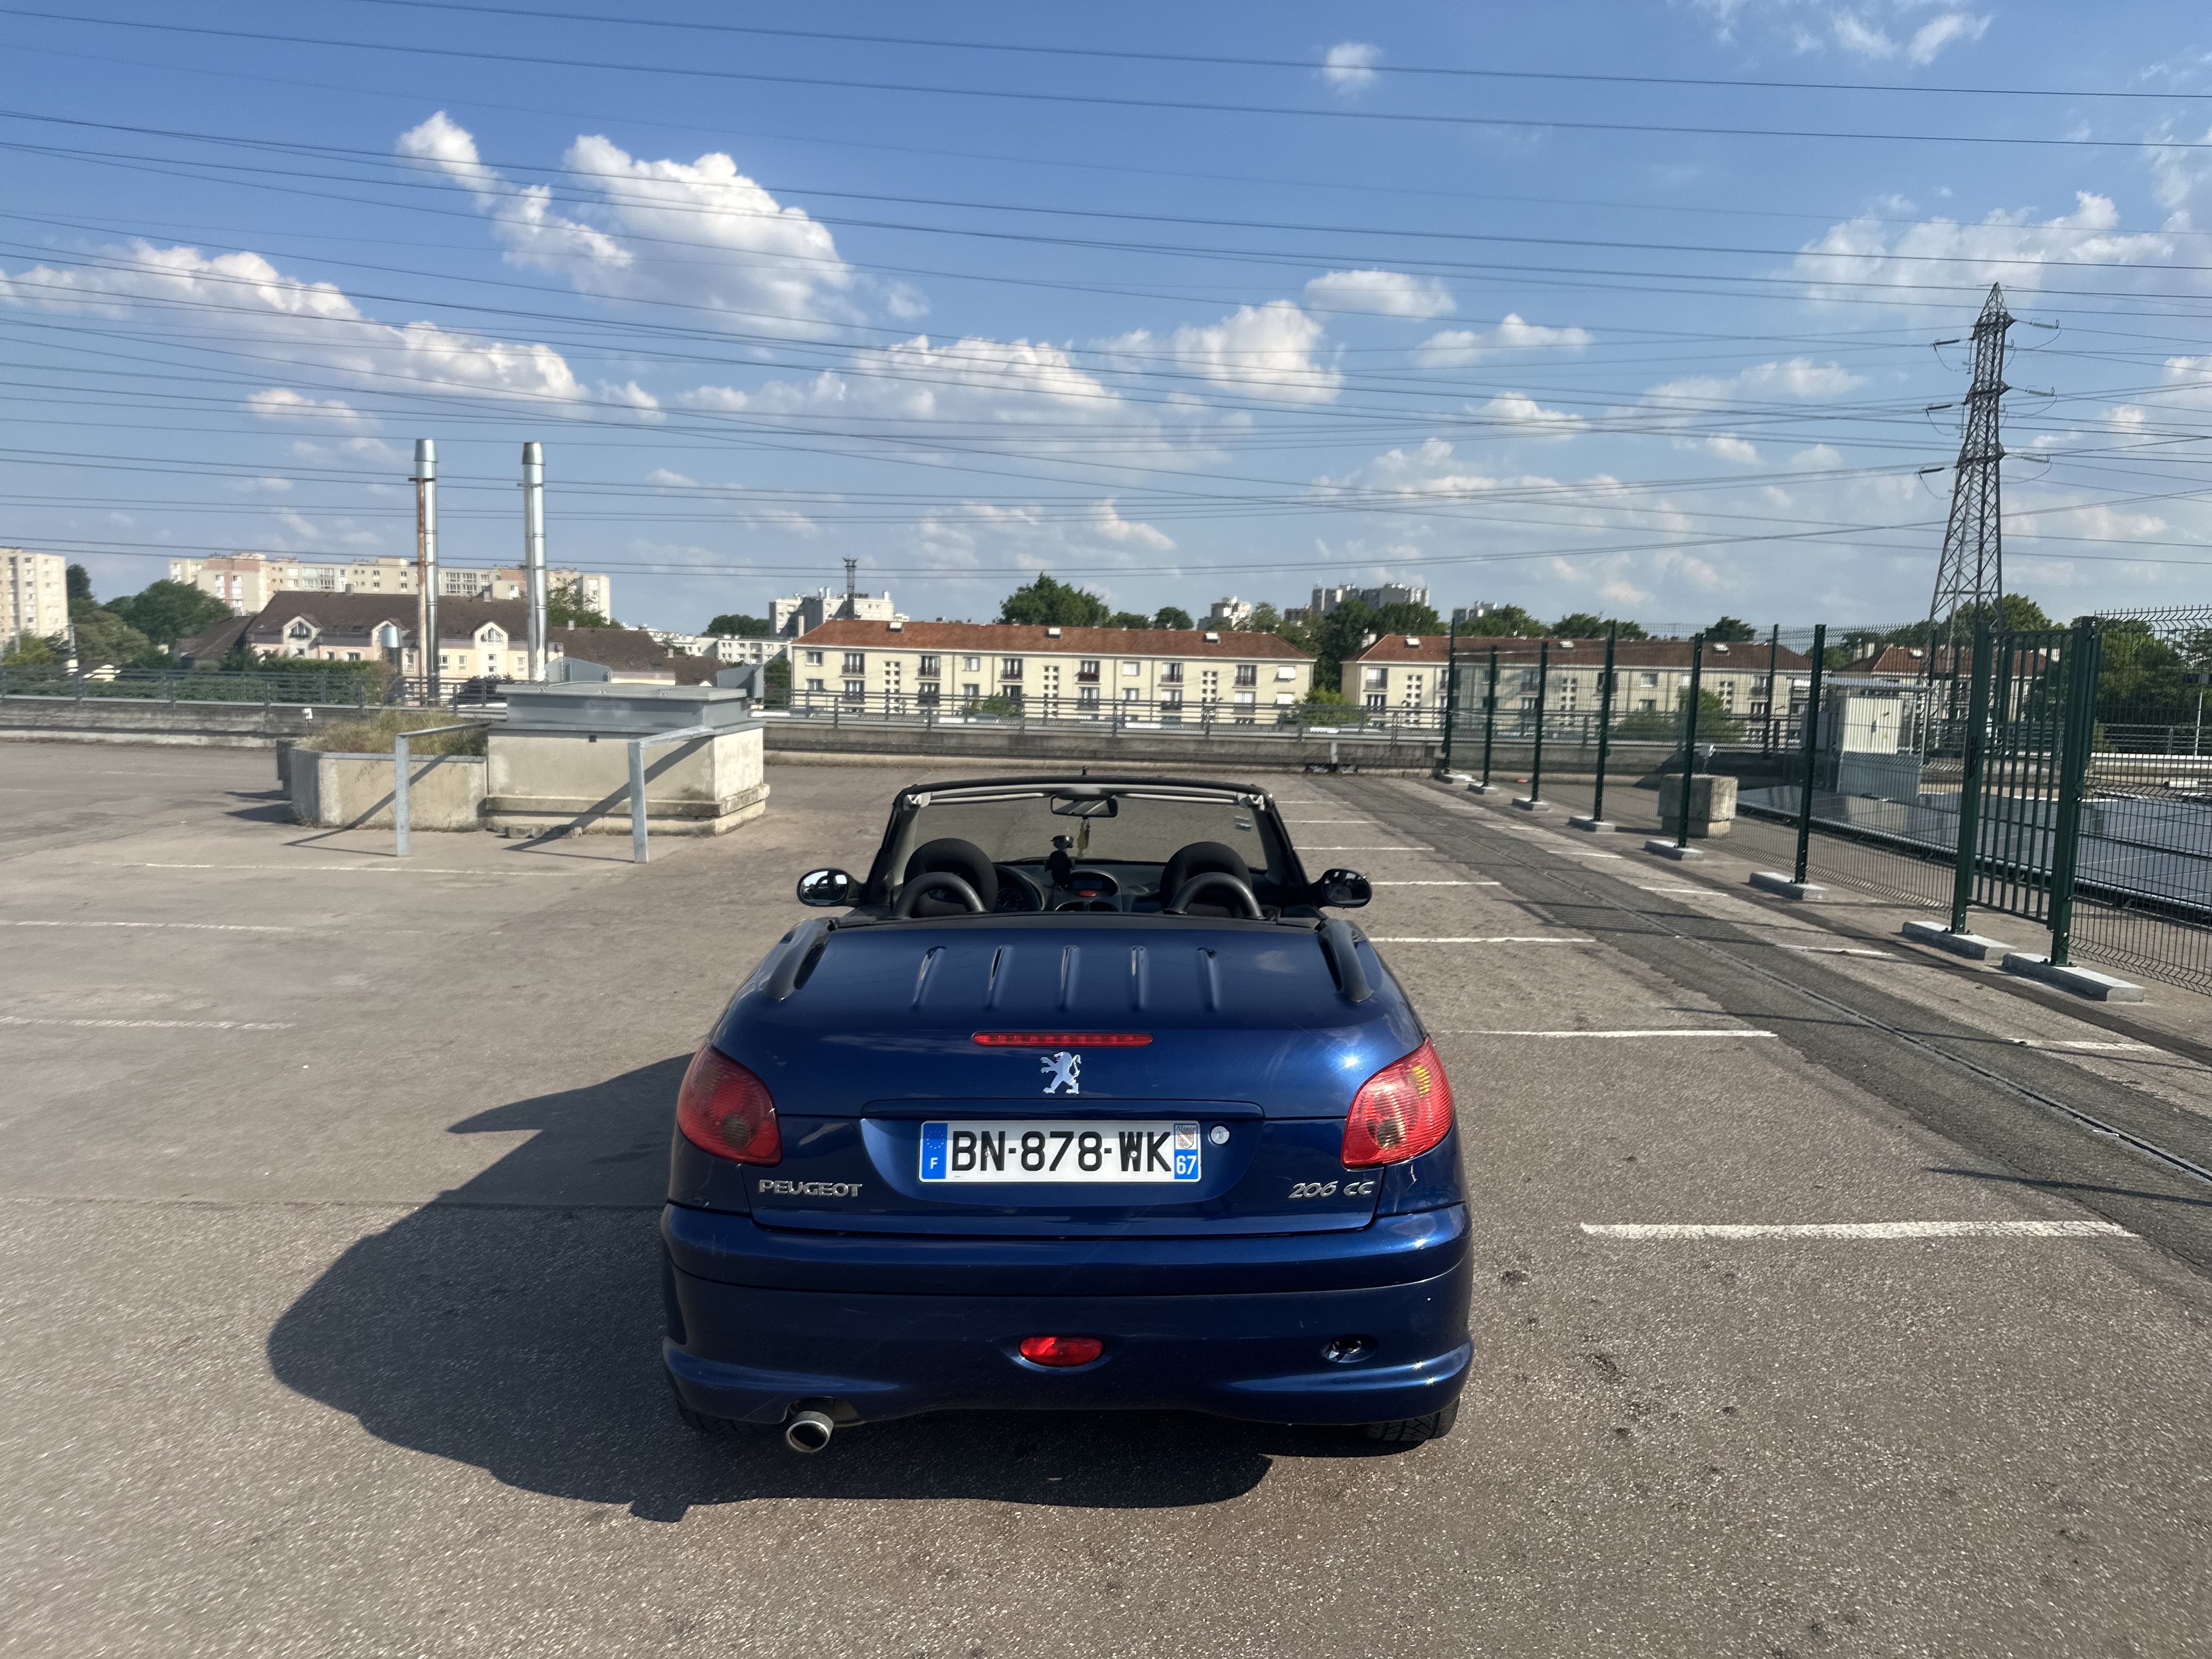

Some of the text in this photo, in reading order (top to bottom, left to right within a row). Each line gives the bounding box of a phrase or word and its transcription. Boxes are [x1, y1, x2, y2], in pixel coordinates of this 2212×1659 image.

[951, 1131, 1172, 1172] BN-878-WK
[930, 1157, 938, 1169] F
[1176, 1155, 1196, 1175] 67
[759, 1179, 863, 1197] PEUGEOT
[1288, 1181, 1375, 1198] 206 CC
